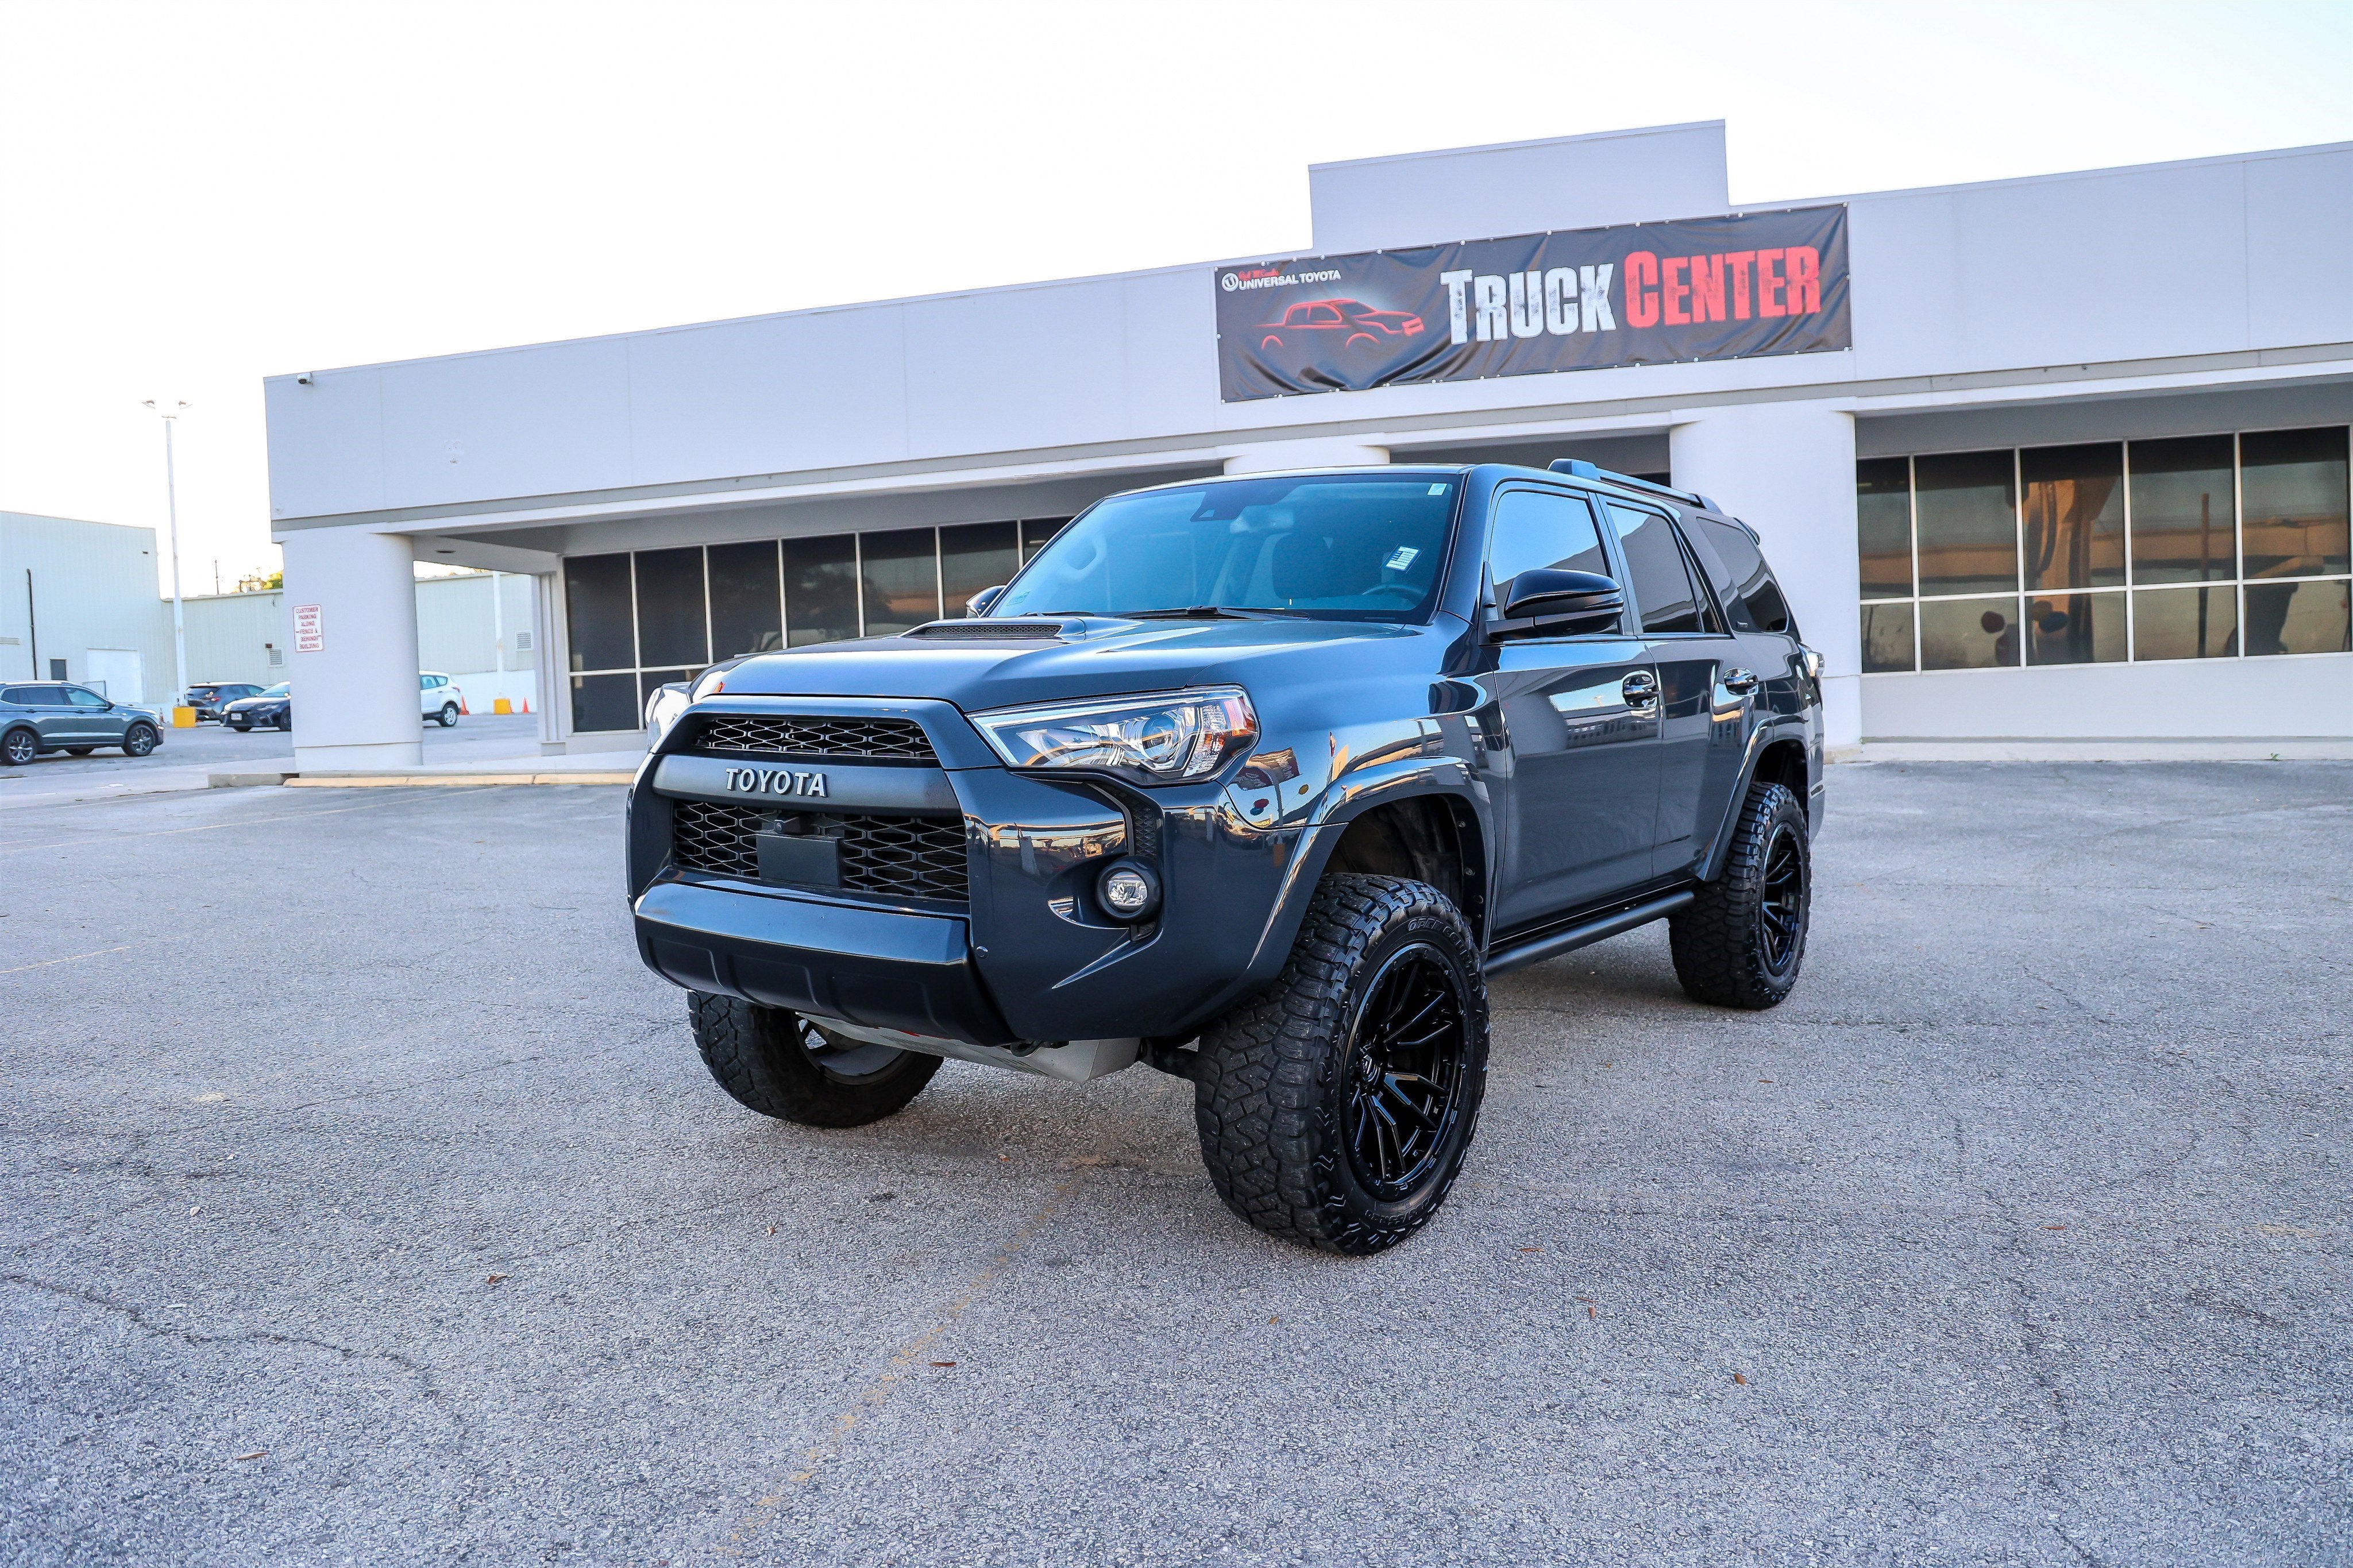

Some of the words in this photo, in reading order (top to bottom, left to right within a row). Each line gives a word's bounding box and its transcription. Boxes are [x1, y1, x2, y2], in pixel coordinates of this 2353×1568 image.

[1238, 273, 1299, 291] UNIVERSAL
[1299, 269, 1341, 284] TOYOTA
[1440, 263, 1617, 345] TRUCK
[1624, 246, 1821, 328] CENTER
[726, 767, 828, 798] TOYOTA
